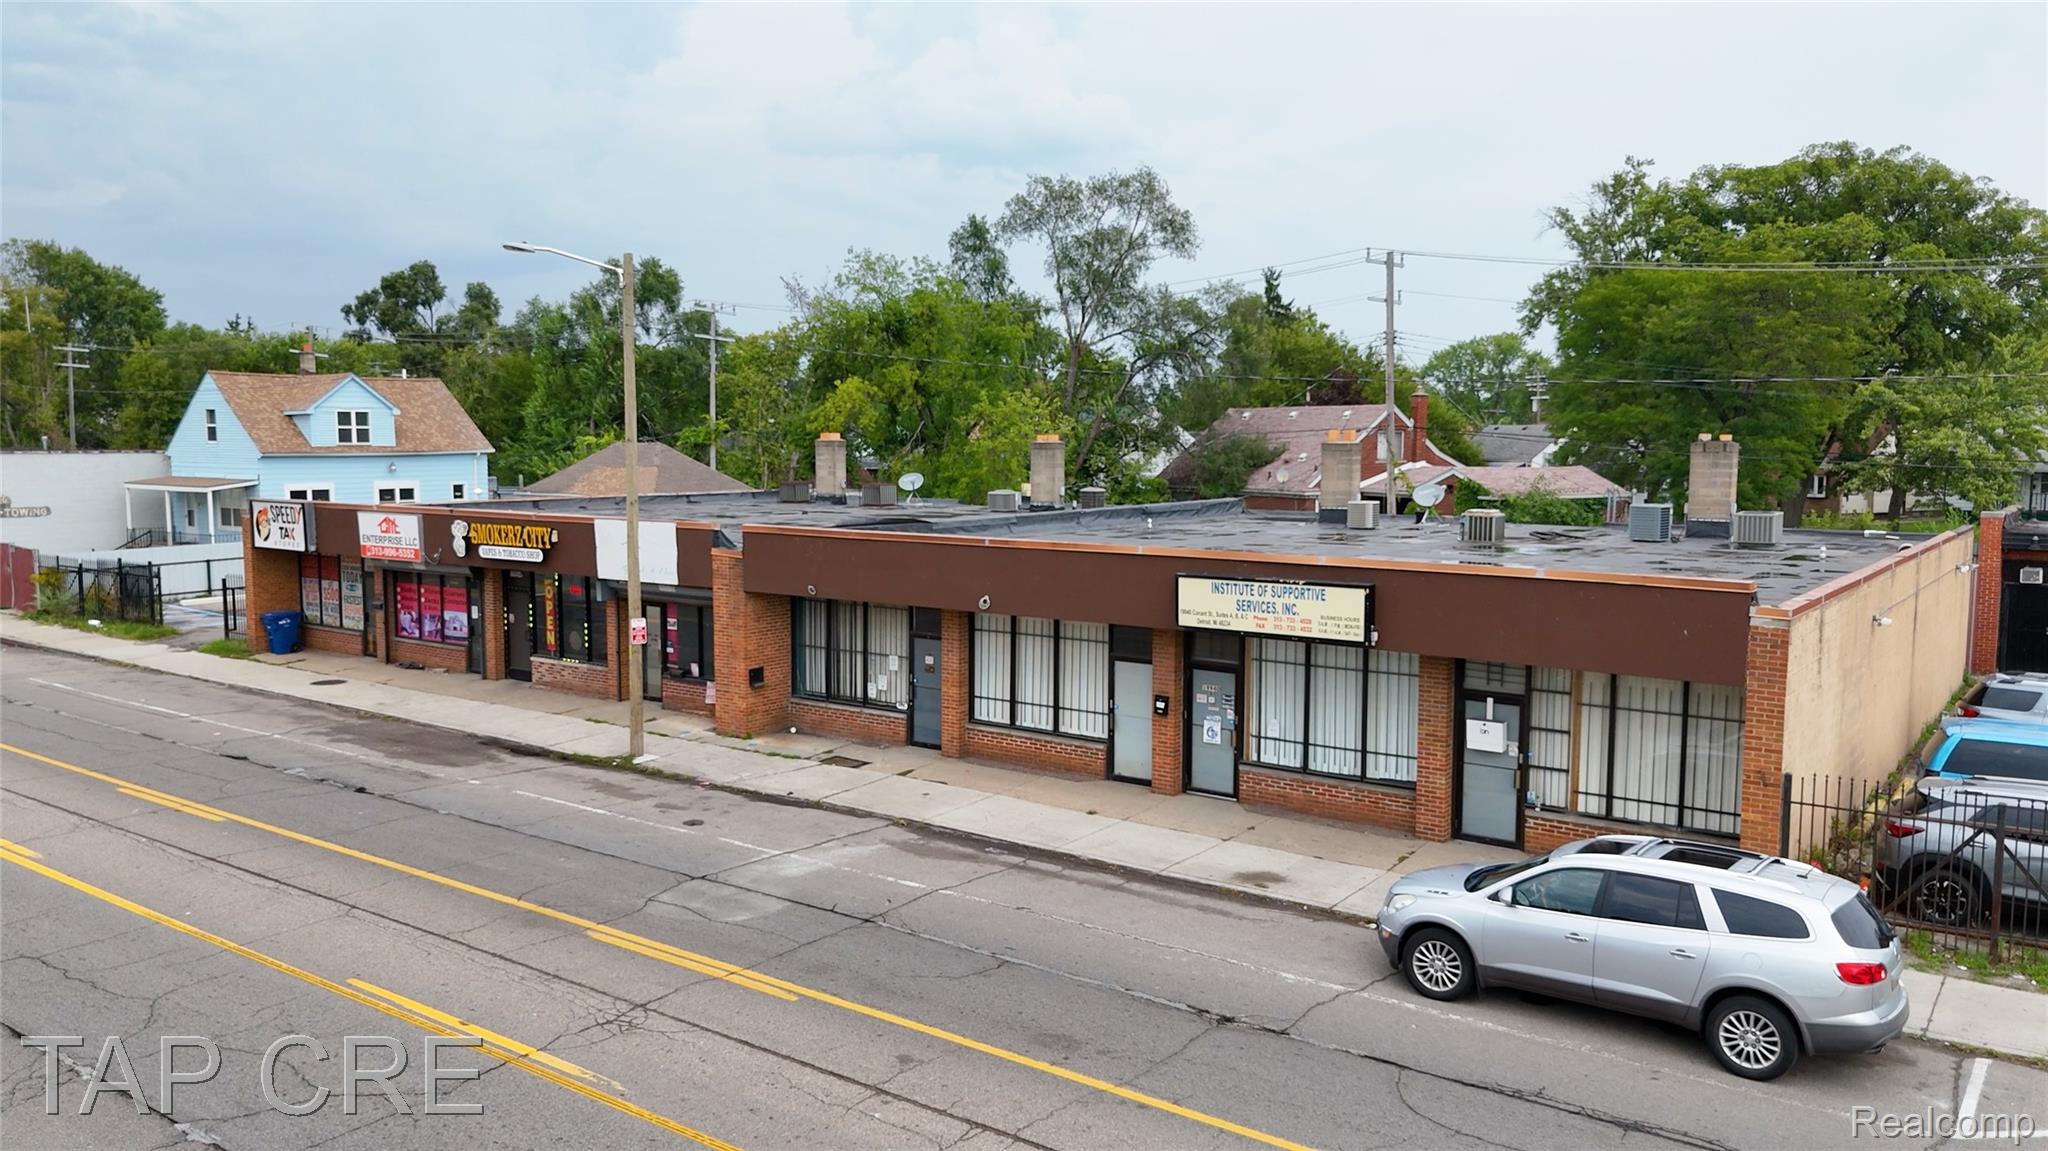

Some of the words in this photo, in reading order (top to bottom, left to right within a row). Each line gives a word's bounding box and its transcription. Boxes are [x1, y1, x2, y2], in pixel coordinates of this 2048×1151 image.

[3, 507, 48, 517] TOWING
[270, 504, 302, 525] SPEEDY
[279, 526, 296, 541] TAX
[362, 534, 403, 546] ENTERPRISE
[404, 537, 418, 547] LLC
[469, 523, 523, 546] SMOKERZ
[523, 526, 551, 549] CITY
[1211, 581, 1255, 597] INSTITUTE
[1257, 584, 1268, 598] OF
[1270, 585, 1326, 602] SUPPORTIVE
[545, 586, 555, 645] OPEN
[1281, 602, 1300, 616] INC.
